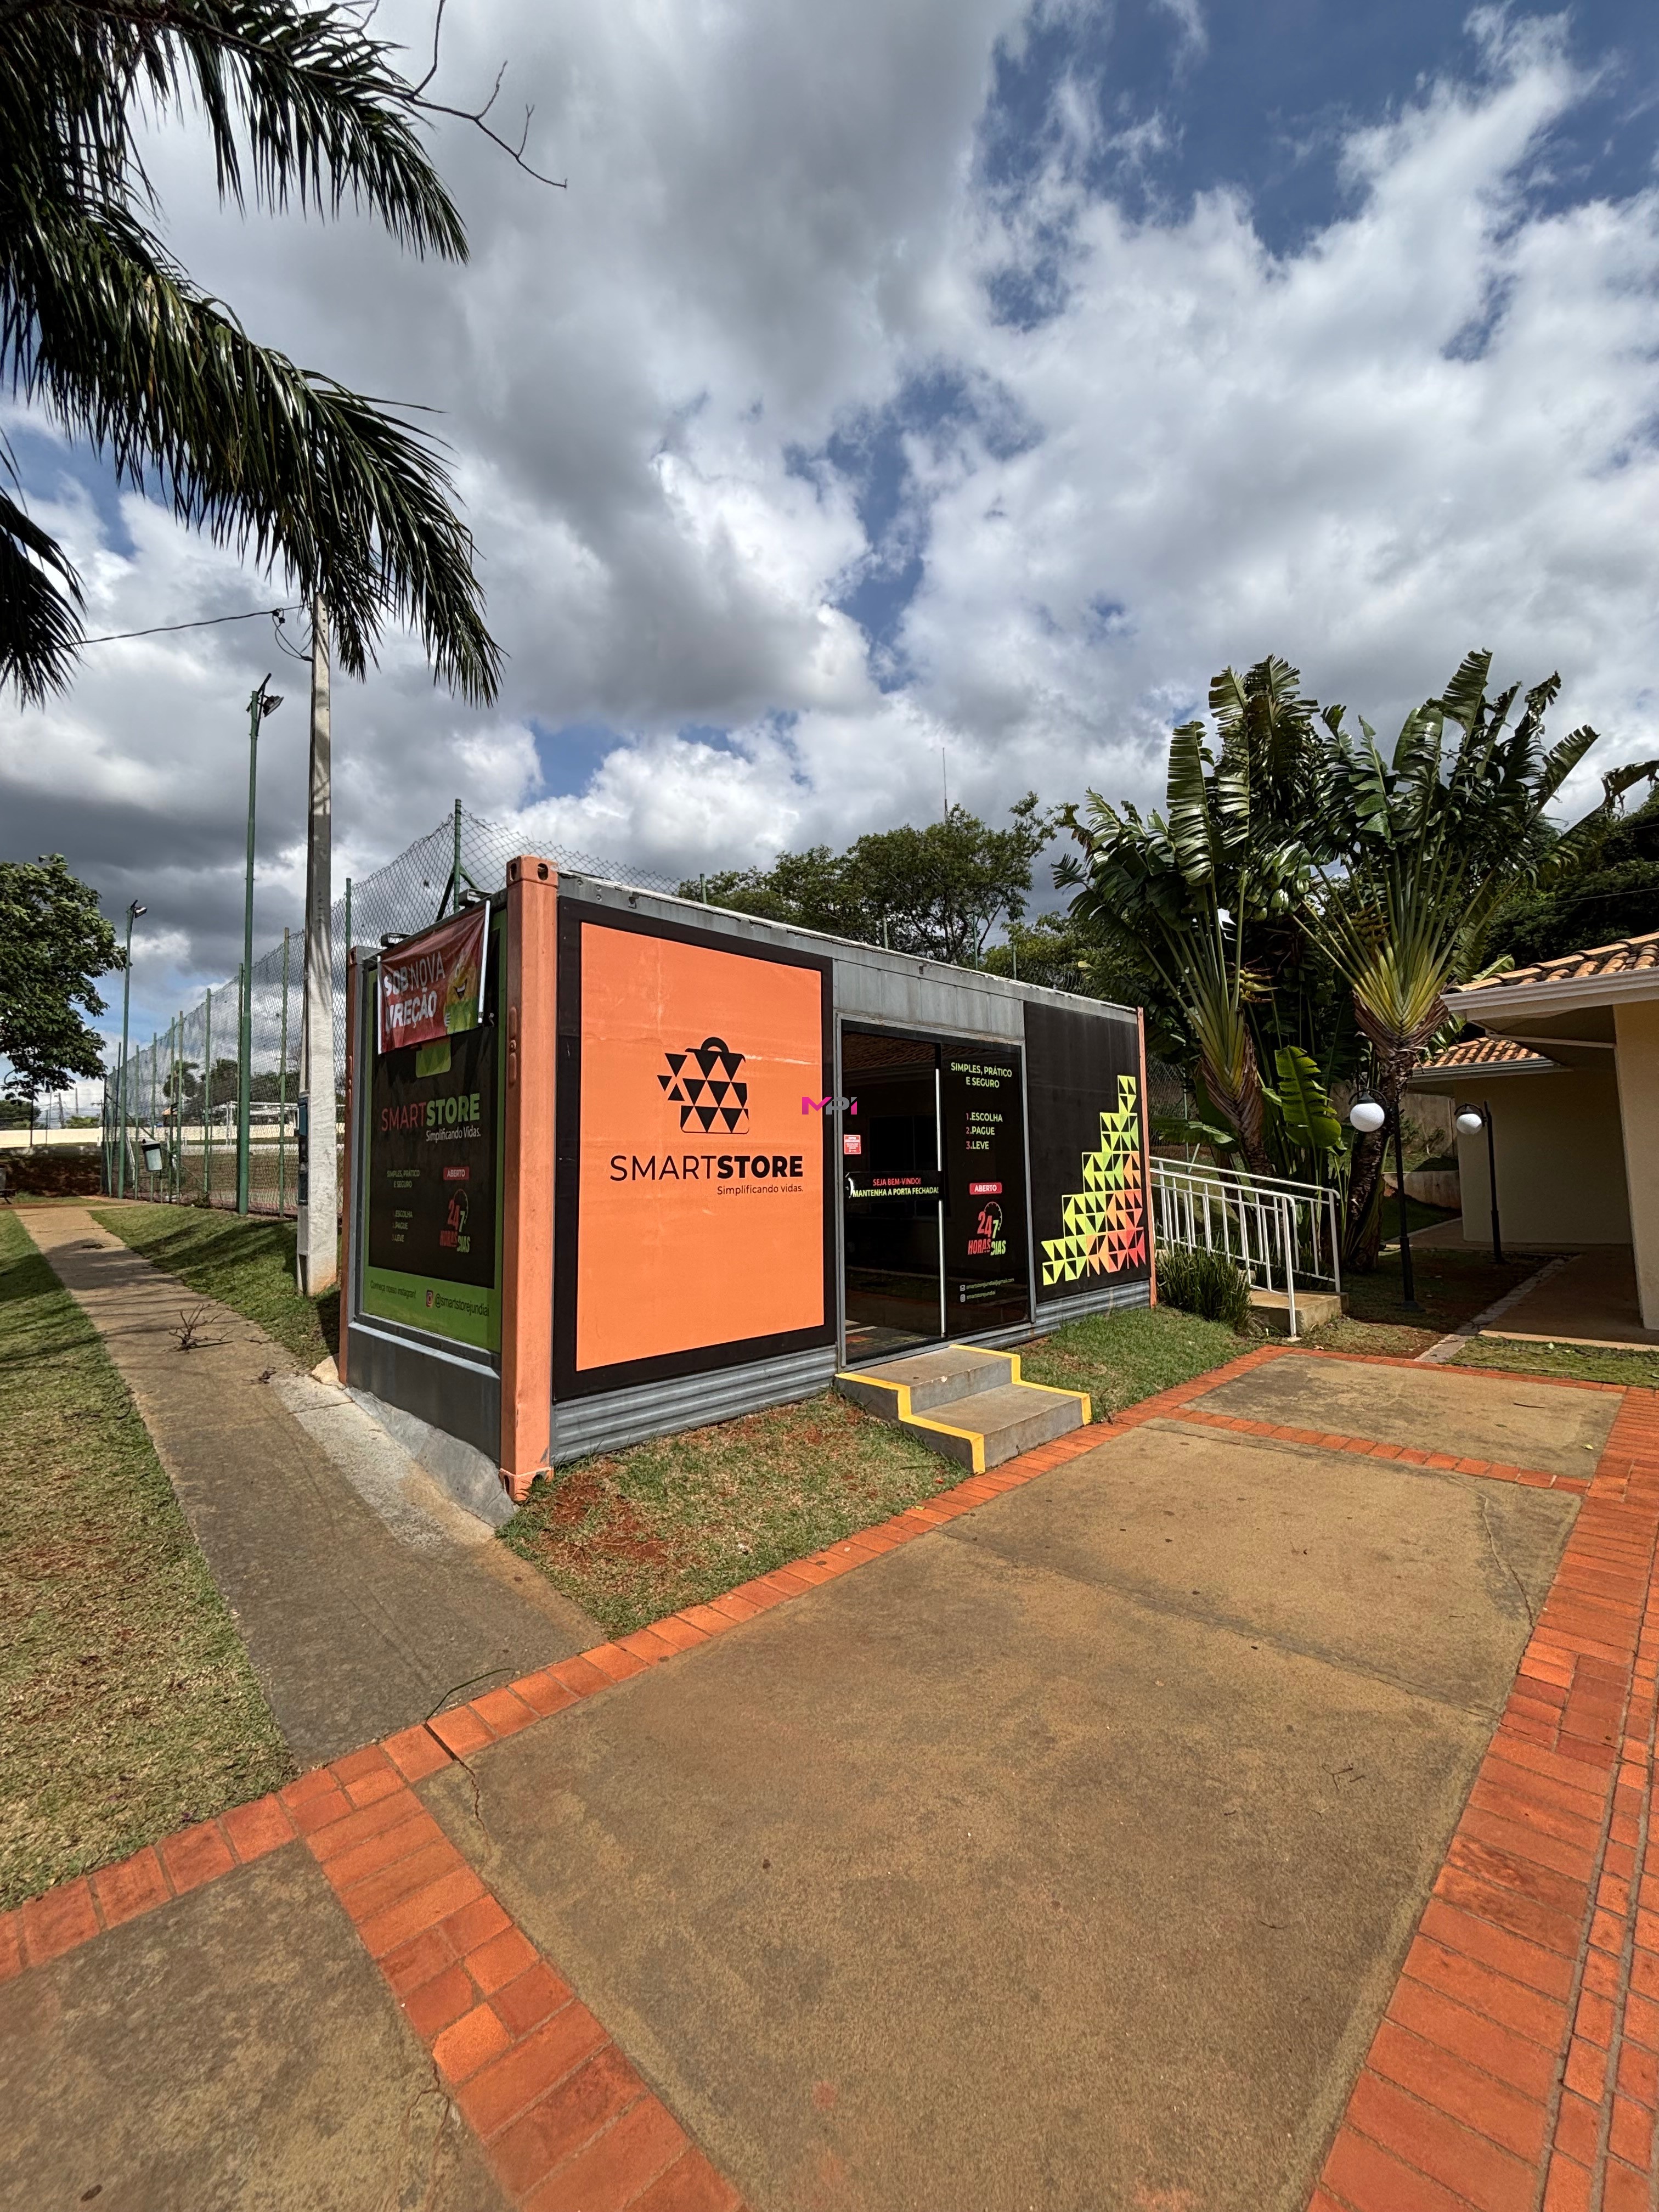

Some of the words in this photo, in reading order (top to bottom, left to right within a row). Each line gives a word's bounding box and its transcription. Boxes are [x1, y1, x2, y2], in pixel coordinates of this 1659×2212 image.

[384, 966, 409, 997] SOB
[410, 951, 445, 991] NOVA
[951, 1062, 983, 1076] SIMPLES,
[984, 1066, 1012, 1077] PRÁTICO
[966, 1077, 970, 1085] E
[972, 1077, 1000, 1088] SEGURO
[381, 1093, 480, 1132] SMARTSTORE
[966, 1112, 1003, 1122] 1.ESCOLHA
[426, 1126, 462, 1143] Simplificando
[463, 1125, 481, 1138] Vidas.
[966, 1126, 995, 1135] 2.PAGUE
[966, 1141, 989, 1150] 3.LEVE
[447, 1169, 465, 1178] ABERTO
[610, 1155, 803, 1181] SMARTSTORE
[873, 1178, 887, 1186] SEJA
[887, 1178, 921, 1186] BEM-VINDO!
[717, 1184, 778, 1196] Simplificando
[781, 1184, 804, 1193] vidas.
[853, 1189, 887, 1197] MANTENHA
[893, 1187, 911, 1196] PORTA
[912, 1186, 939, 1195] FECHADA!
[974, 1184, 997, 1192] ABERTO
[968, 1239, 991, 1255] HORAS
[990, 1240, 1006, 1256] DIAS
[435, 1293, 490, 1317] @smartstorejundiai
